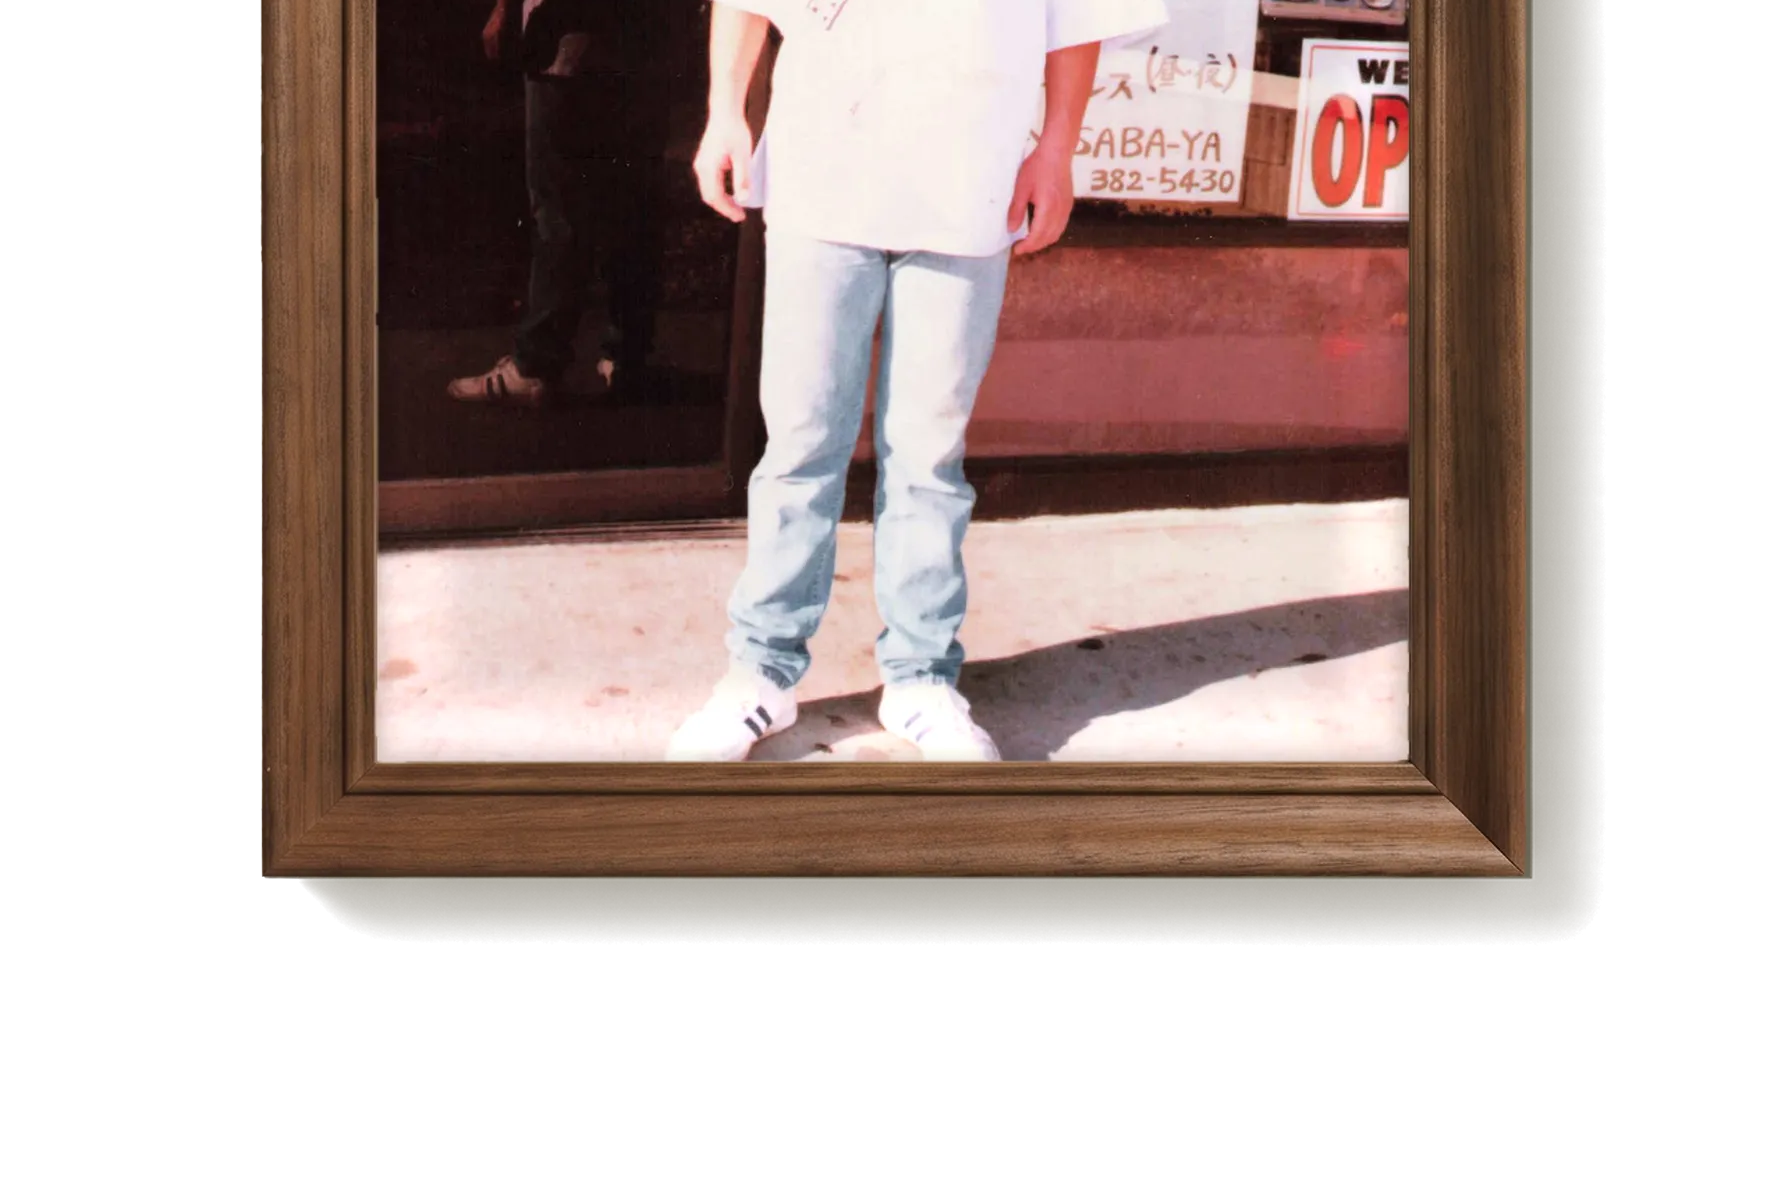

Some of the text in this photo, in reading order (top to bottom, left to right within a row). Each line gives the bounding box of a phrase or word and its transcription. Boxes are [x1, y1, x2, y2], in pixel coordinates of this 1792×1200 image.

[1357, 58, 1409, 85] WE
[1074, 126, 1221, 163] SABA-YA
[1311, 93, 1409, 208] OP
[1090, 166, 1235, 194] 382-5430
